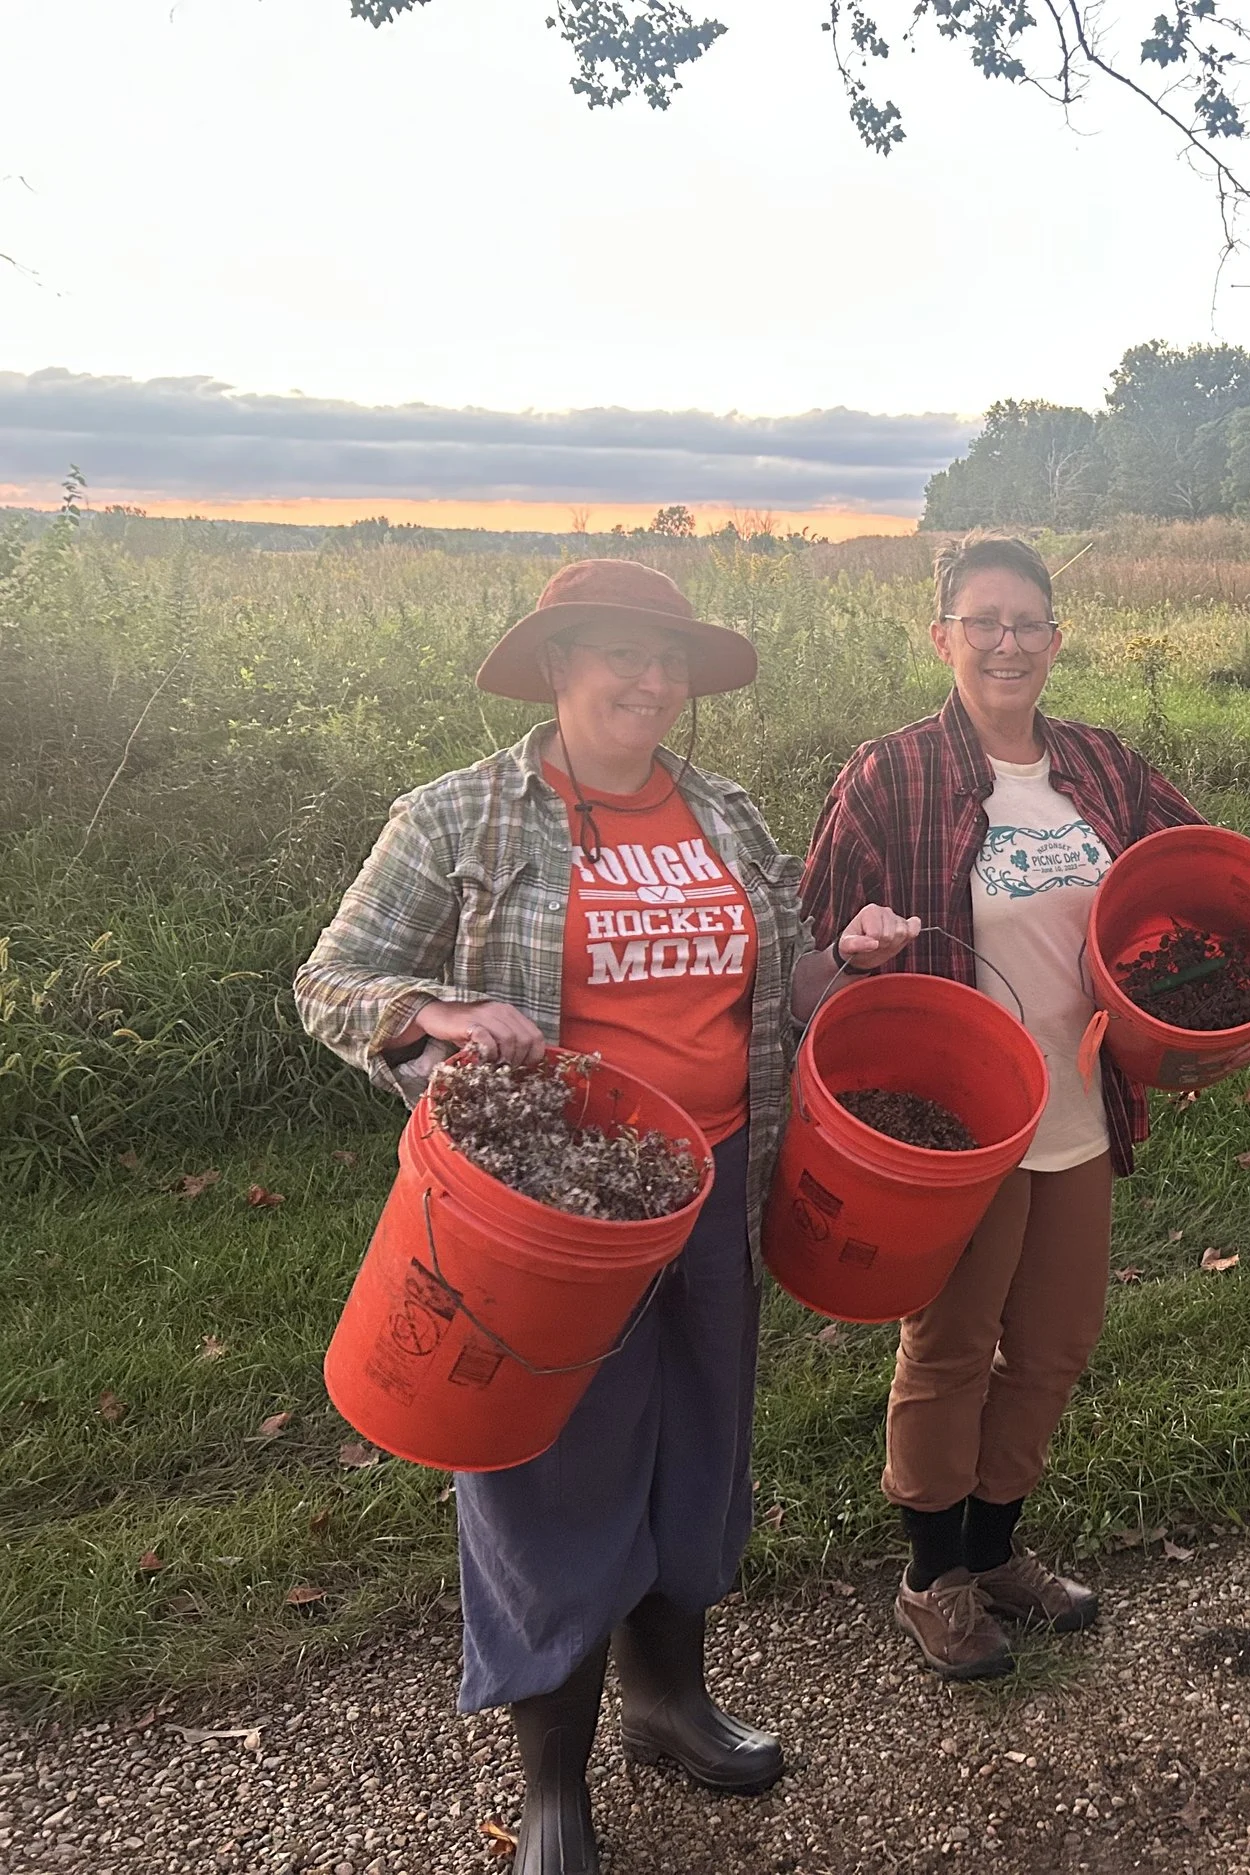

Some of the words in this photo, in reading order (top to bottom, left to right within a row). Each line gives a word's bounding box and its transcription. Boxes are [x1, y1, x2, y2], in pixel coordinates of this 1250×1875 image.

[1031, 853, 1062, 867] PICNIC
[1063, 850, 1081, 864] DAY
[584, 904, 745, 940] HOCKEY
[586, 934, 749, 985] MOM
